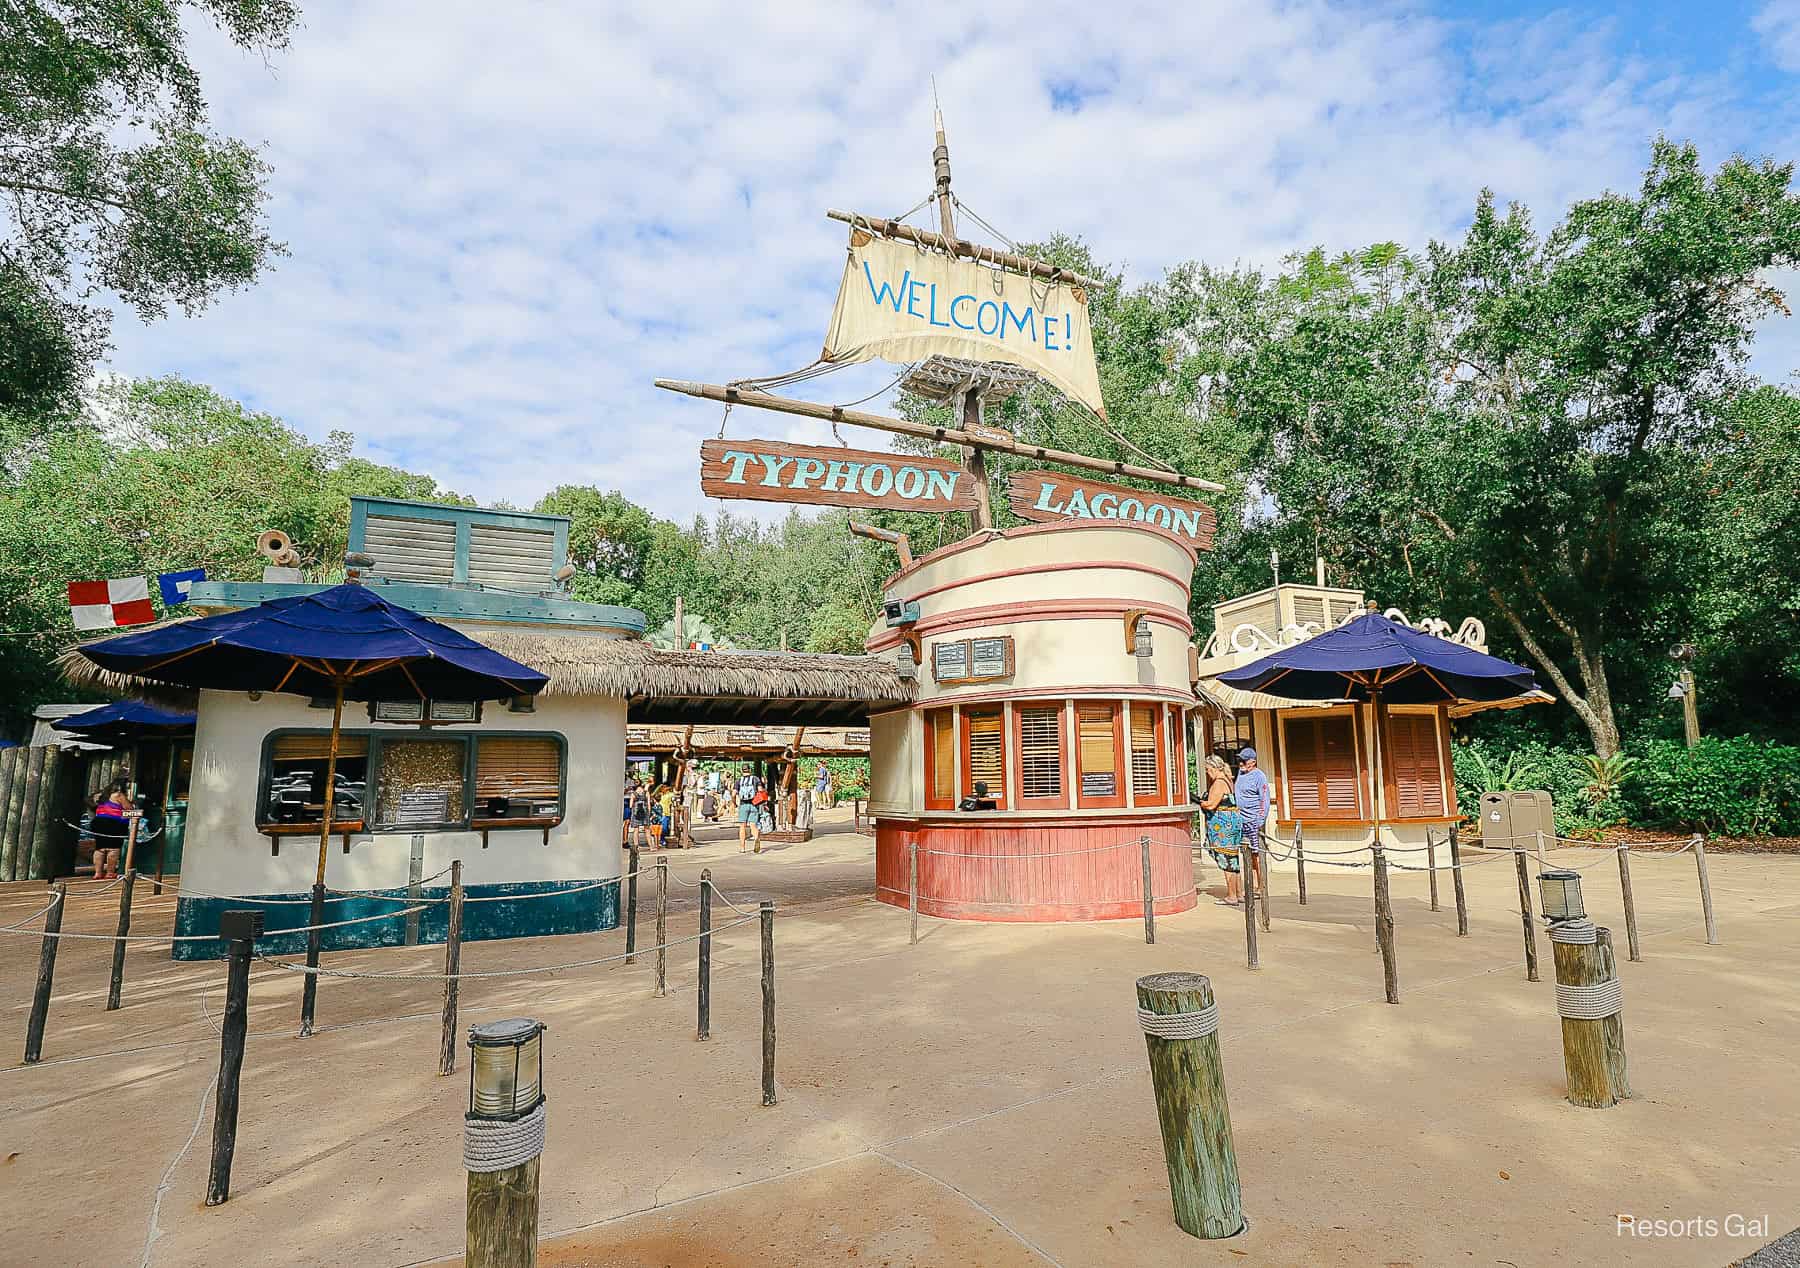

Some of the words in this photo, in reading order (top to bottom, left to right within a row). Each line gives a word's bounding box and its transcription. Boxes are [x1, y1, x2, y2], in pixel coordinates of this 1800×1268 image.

[863, 260, 1072, 351] WELCOME!
[721, 450, 961, 501] TYPHOON
[1033, 482, 1202, 539] LAGOON
